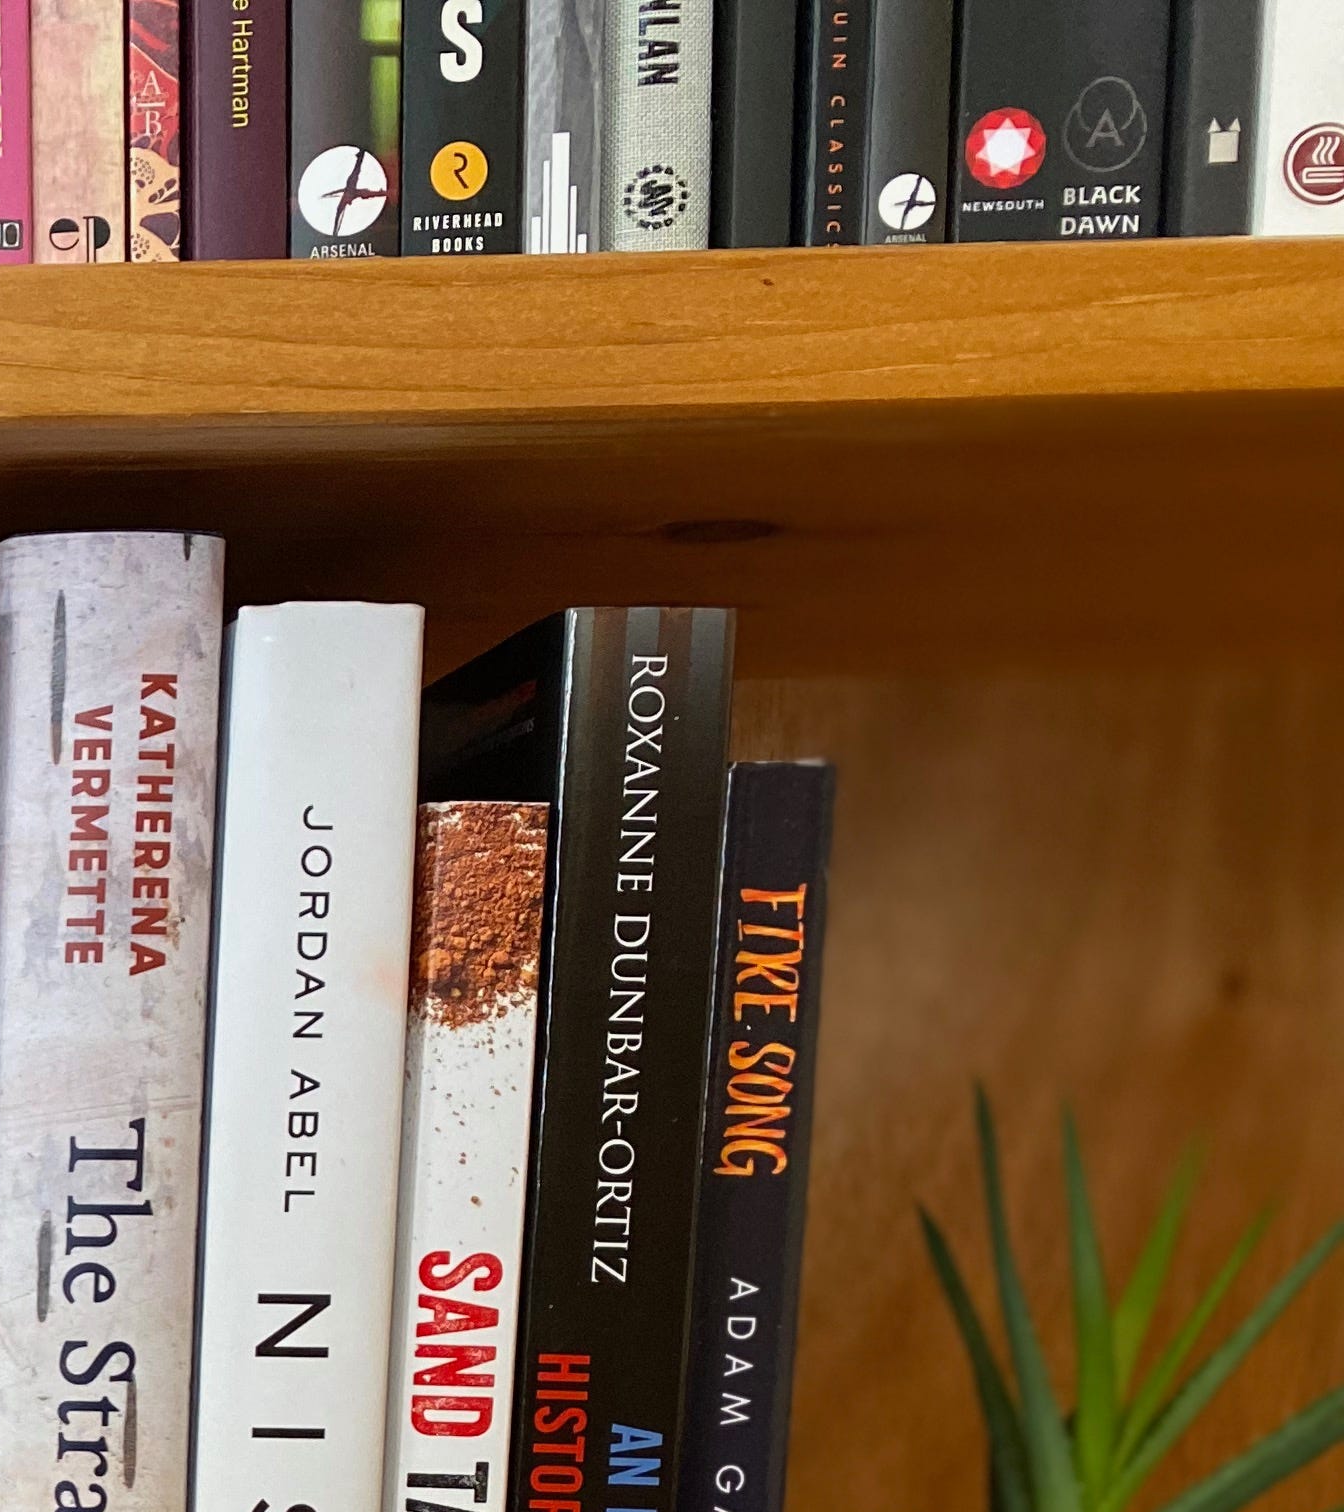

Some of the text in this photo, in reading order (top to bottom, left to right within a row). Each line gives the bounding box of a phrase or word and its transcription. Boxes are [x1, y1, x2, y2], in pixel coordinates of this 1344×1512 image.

[230, 19, 254, 129] Hartman
[311, 242, 376, 260] ARSENAL
[412, 212, 503, 232] RIVERHEAD
[431, 236, 485, 253] BOOKS
[962, 200, 1045, 213] NEWSOUTH
[1059, 213, 1140, 236] DAWN
[1062, 184, 1142, 207] BLACK
[63, 704, 114, 964] VERMETTE
[128, 673, 178, 977] KATHERENA
[284, 805, 333, 1212] JORDAN ABEL
[591, 653, 669, 1284] ROXANNE DUNBAR-ORTIZ
[713, 882, 808, 1177] FIRE SONG
[61, 1117, 154, 1303] The
[410, 1251, 503, 1437] SAND
[719, 1277, 760, 1427] ADAM
[607, 1423, 664, 1487] AN
